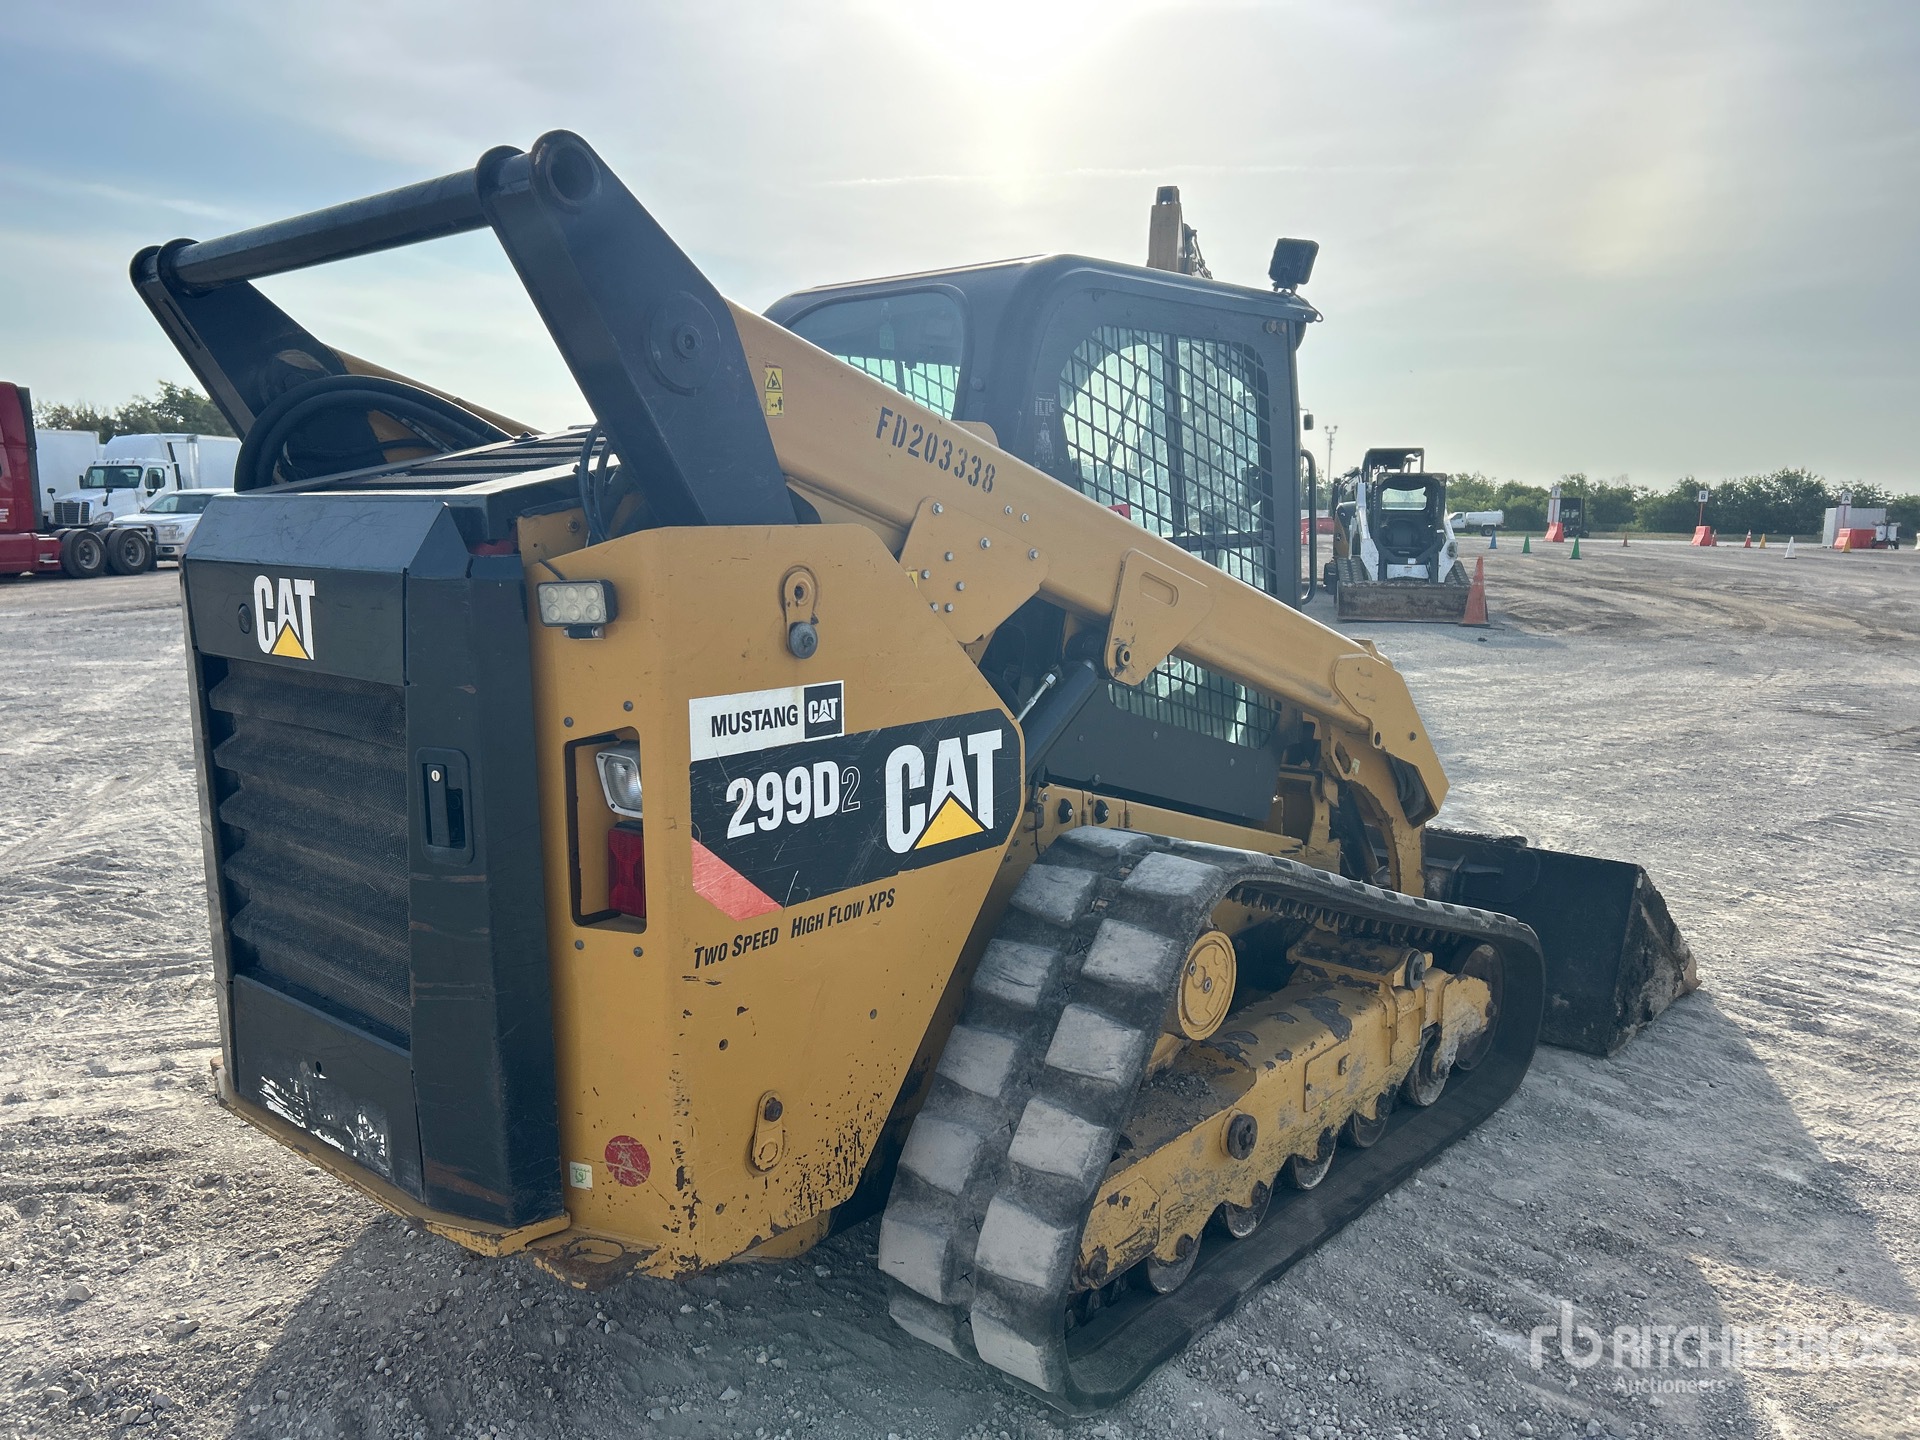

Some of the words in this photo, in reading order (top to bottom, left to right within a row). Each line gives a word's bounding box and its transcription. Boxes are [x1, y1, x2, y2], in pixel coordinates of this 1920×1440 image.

[876, 406, 996, 493] FD203338
[254, 575, 316, 660] CAT
[711, 704, 798, 737] MUSTANG
[808, 697, 839, 724] CAT
[726, 760, 861, 839] 299D2
[885, 729, 1002, 854] CAT
[866, 887, 896, 914] XPS
